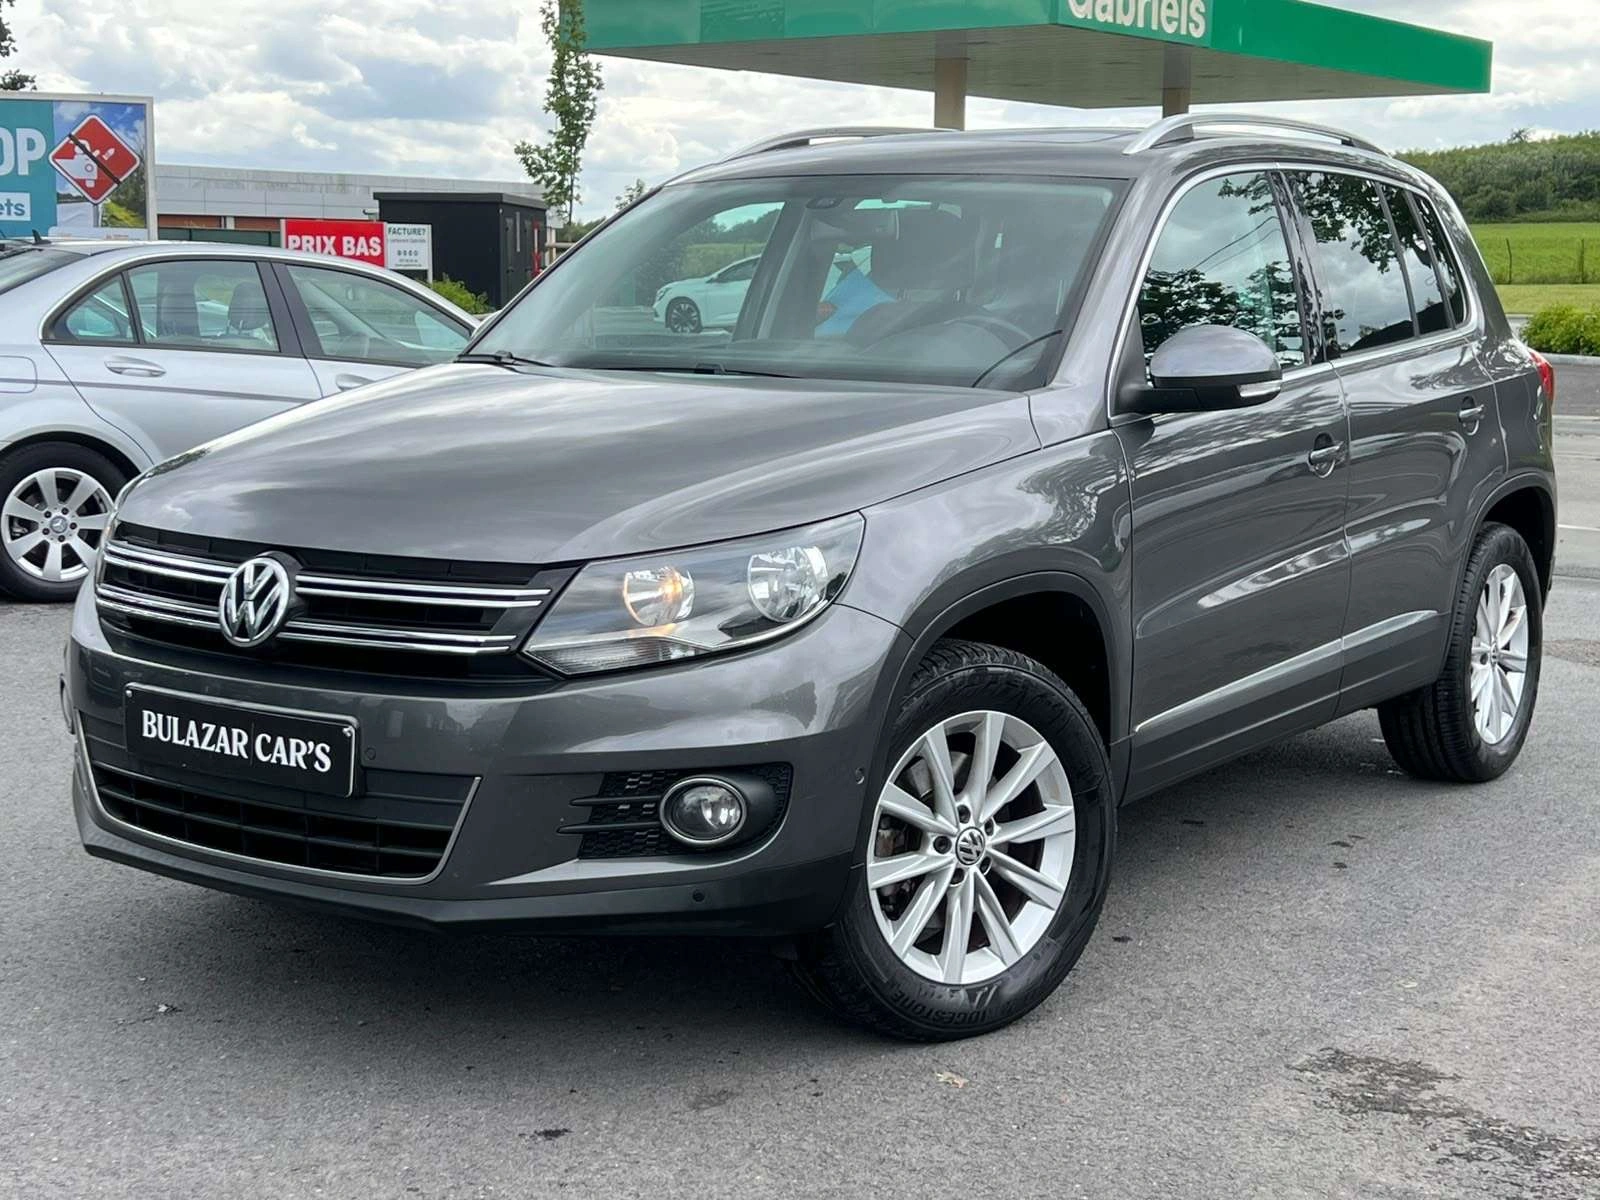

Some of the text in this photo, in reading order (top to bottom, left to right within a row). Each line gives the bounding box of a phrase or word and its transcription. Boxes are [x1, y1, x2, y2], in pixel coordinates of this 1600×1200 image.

[287, 235, 382, 257] PRIX BAS
[142, 709, 332, 773] BULAZAR CAR'S
